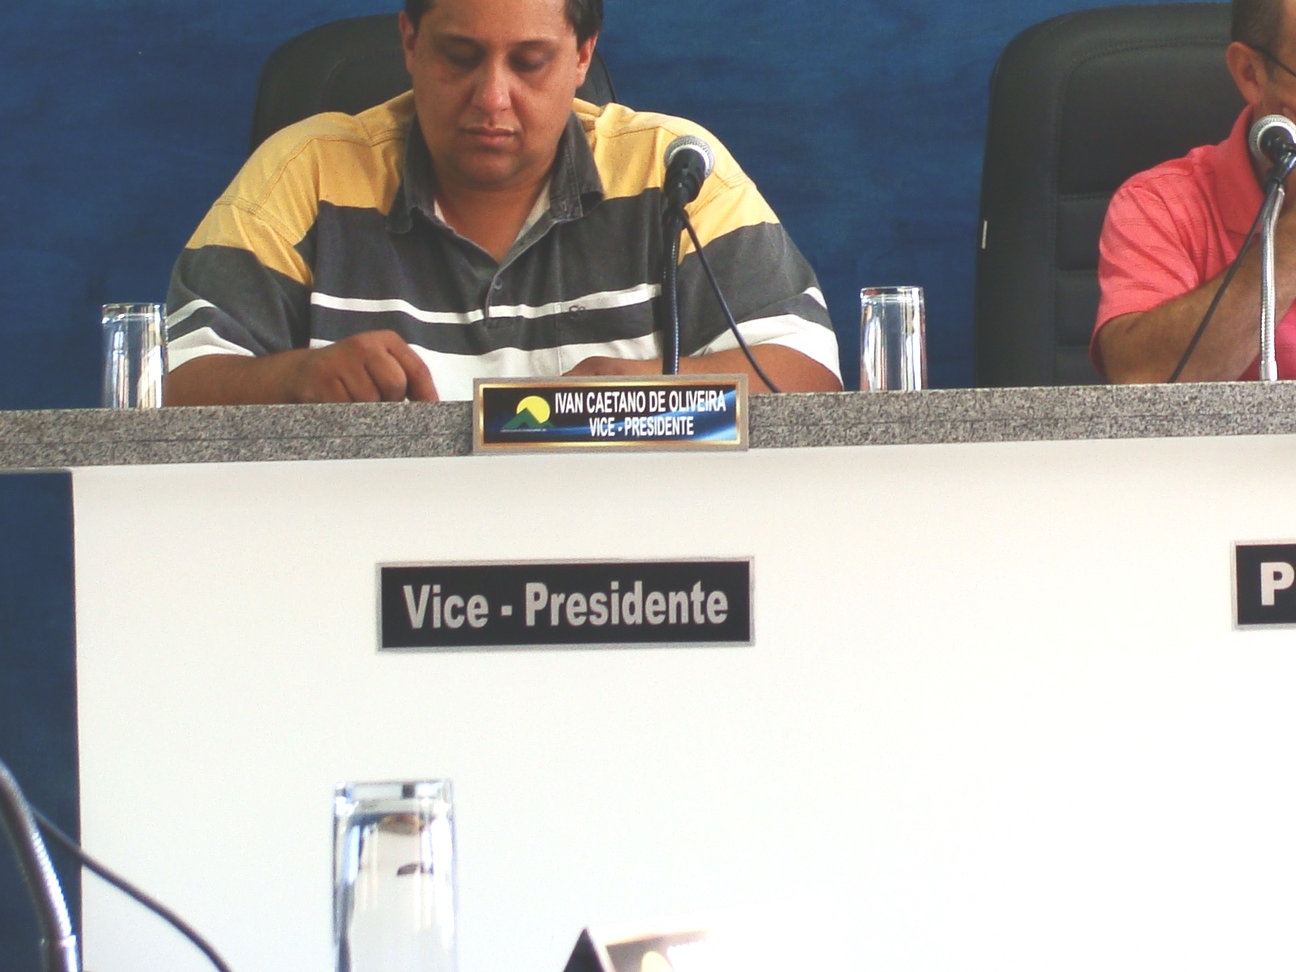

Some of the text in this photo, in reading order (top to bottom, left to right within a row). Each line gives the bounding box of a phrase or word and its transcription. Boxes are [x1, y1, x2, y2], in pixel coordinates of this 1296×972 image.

[555, 390, 726, 414] IVAN CAETANO DE OLIVEIRA
[590, 418, 615, 436] VICE
[625, 417, 694, 436] PRESIDENTE
[403, 584, 489, 629] Vice
[525, 580, 728, 626] Presidente
